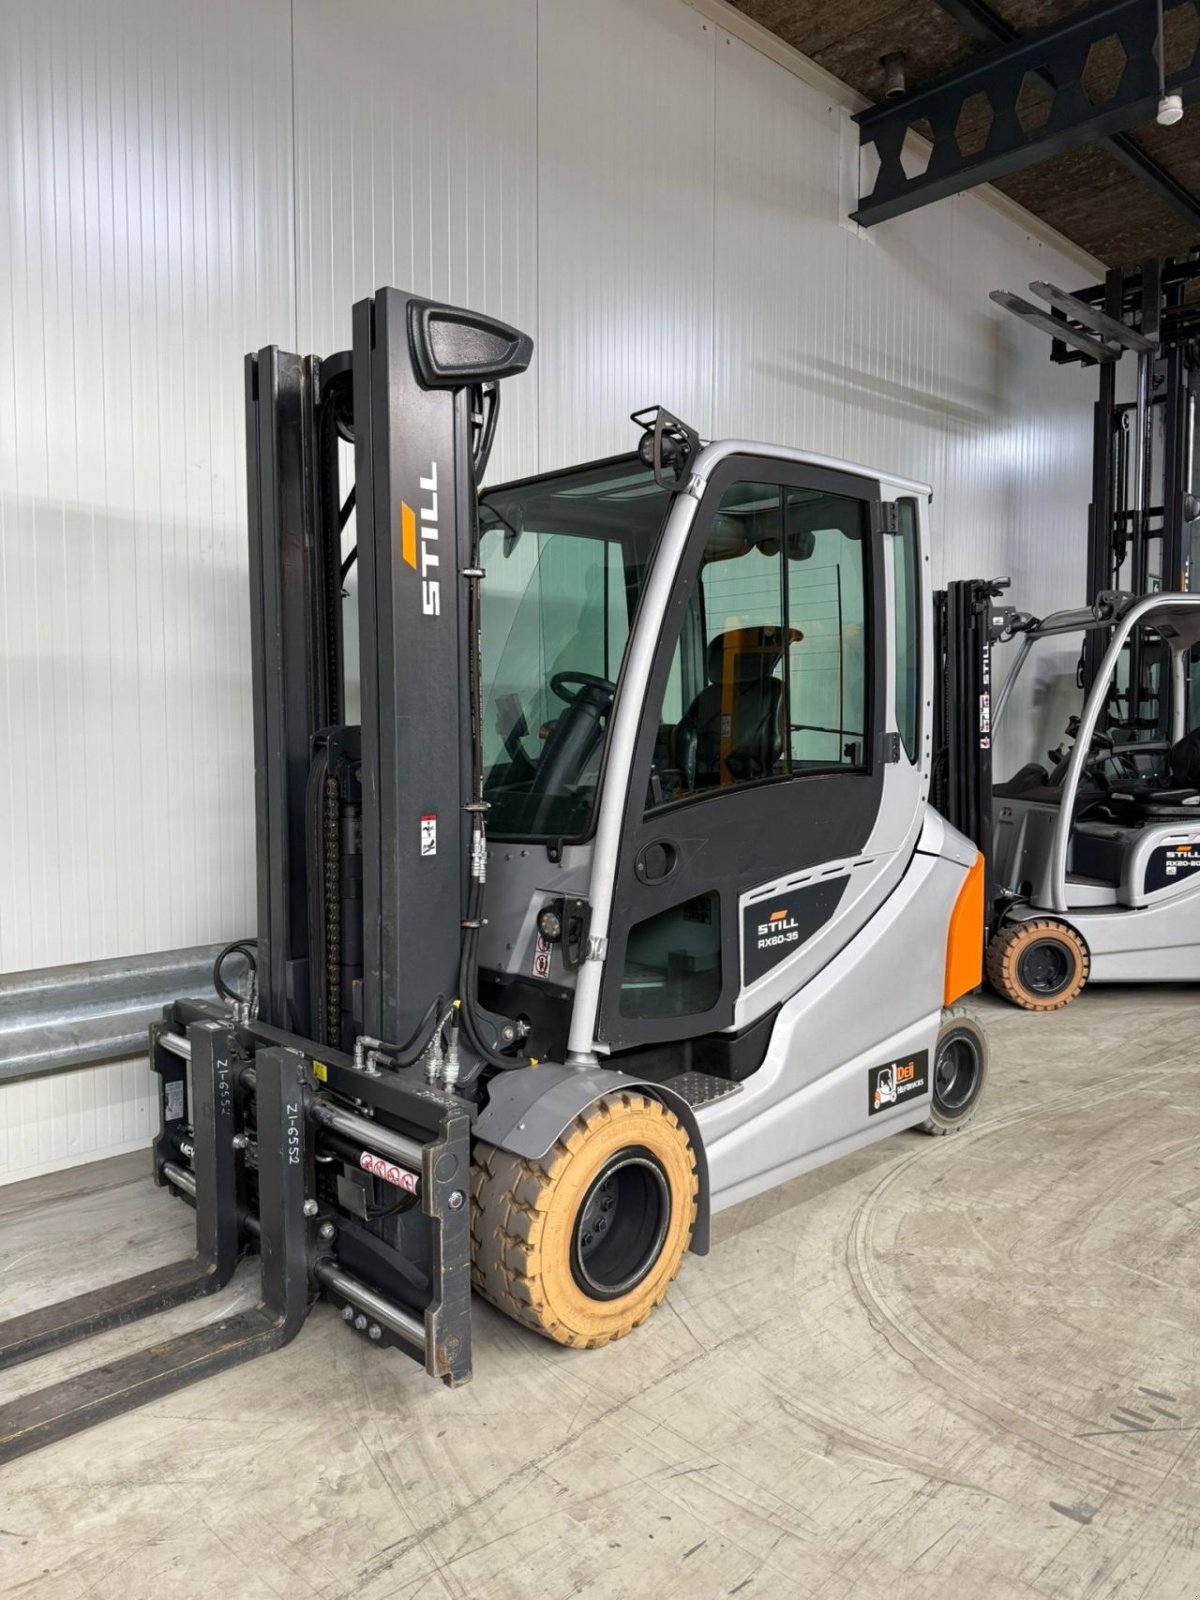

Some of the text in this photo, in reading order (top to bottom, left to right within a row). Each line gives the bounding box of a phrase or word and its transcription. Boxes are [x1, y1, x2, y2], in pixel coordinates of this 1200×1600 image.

[420, 461, 441, 616] STILL
[982, 641, 990, 685] STILL
[757, 918, 799, 936] STILL
[757, 931, 799, 949] RX60-35
